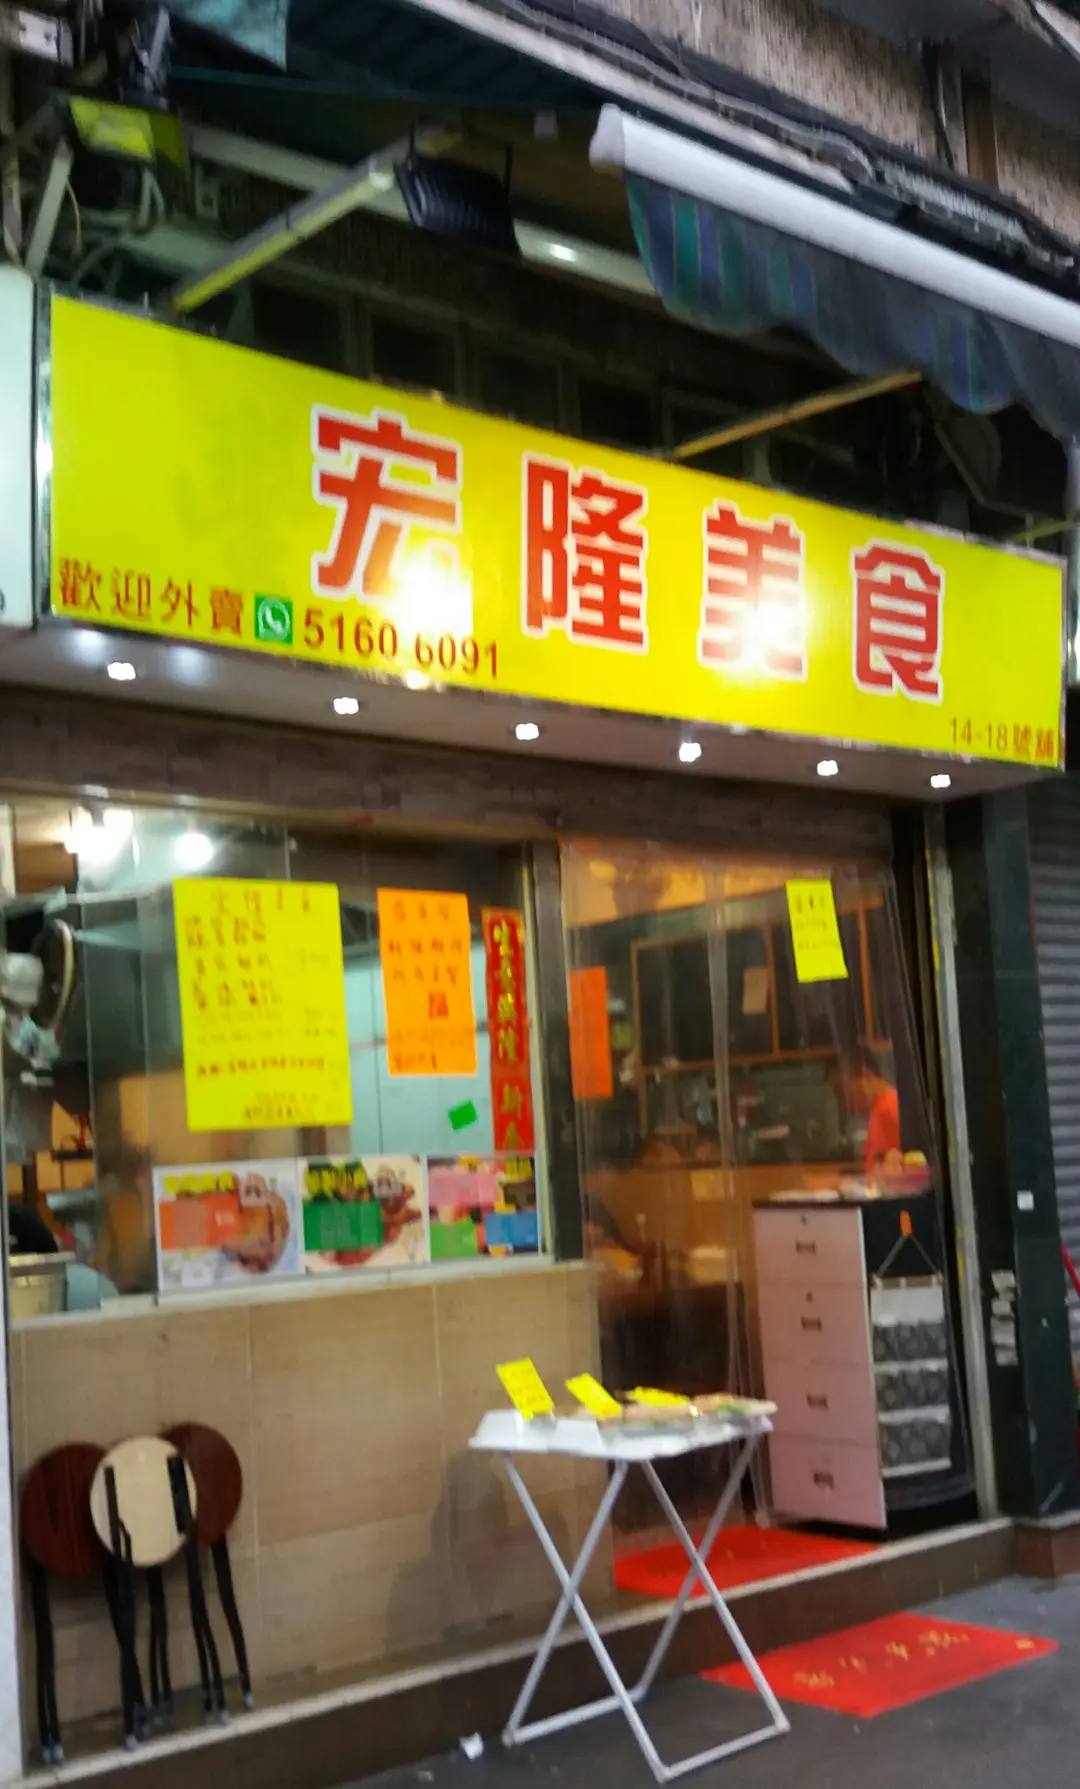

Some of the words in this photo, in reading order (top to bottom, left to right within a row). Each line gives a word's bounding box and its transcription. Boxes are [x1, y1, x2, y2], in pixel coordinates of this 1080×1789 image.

[60, 558, 242, 636] 歡迎外賣
[304, 606, 398, 660] 5160
[414, 631, 498, 679] 6091
[314, 406, 944, 702] 宏隆美食
